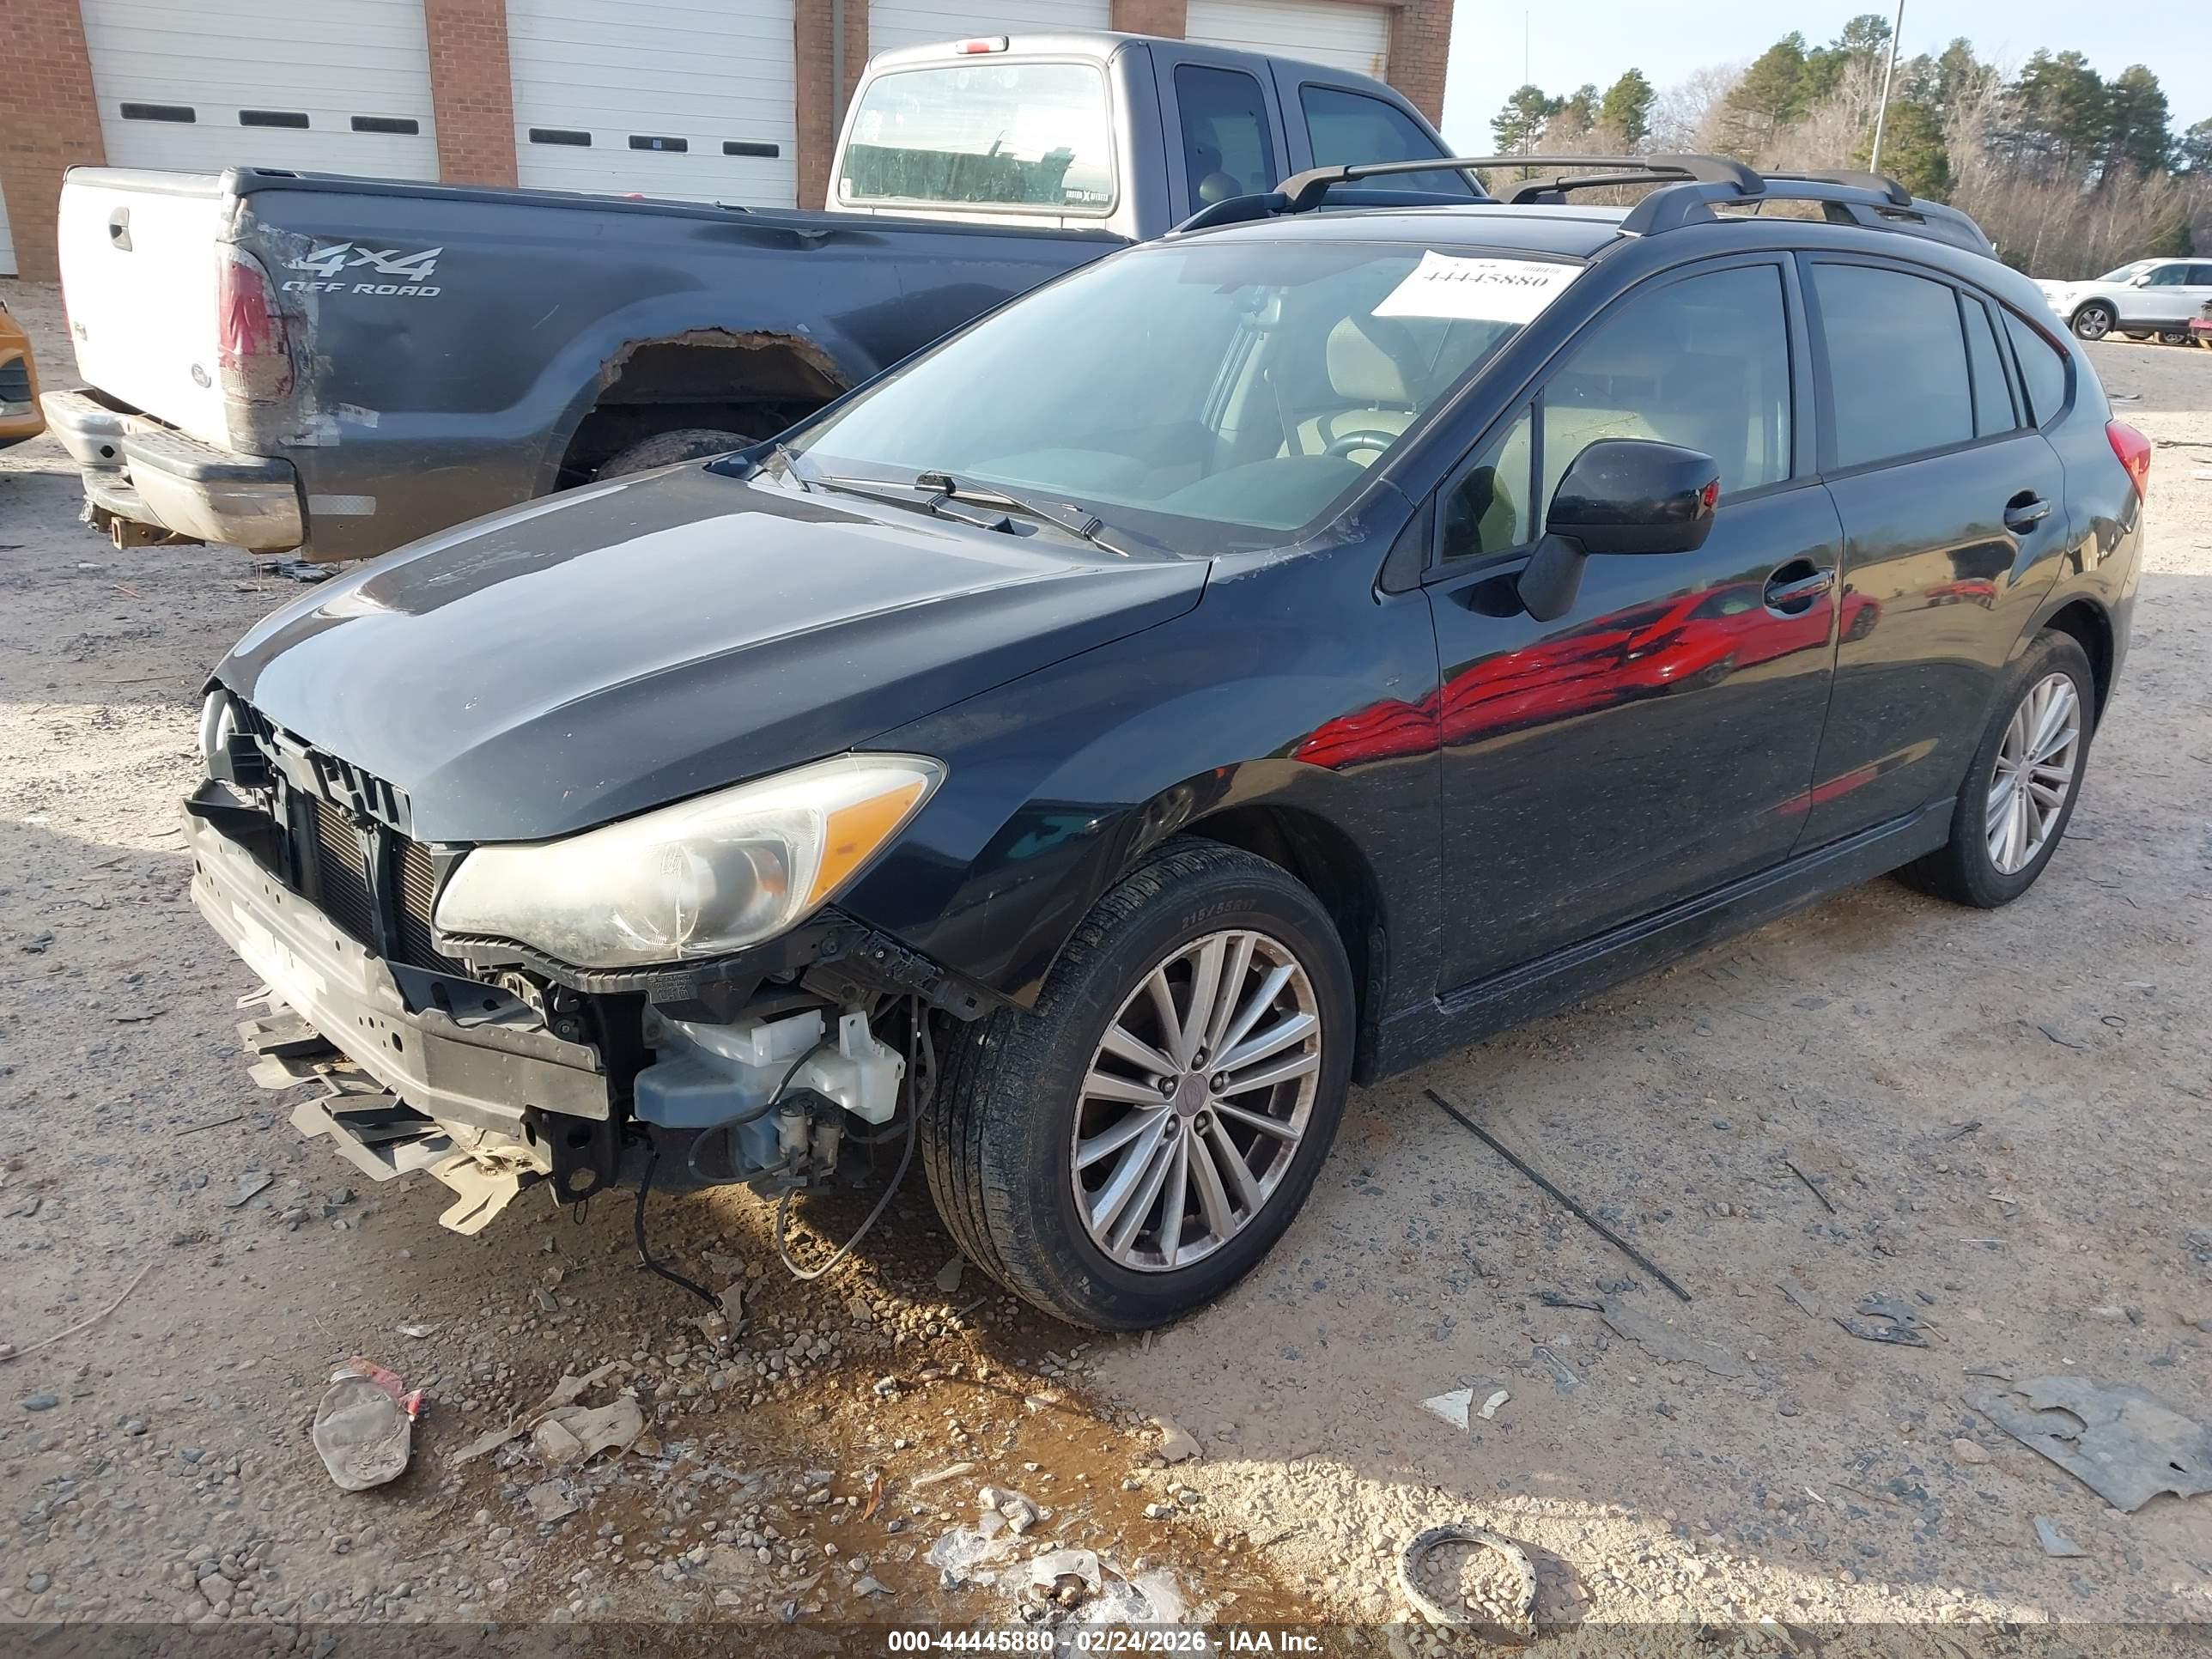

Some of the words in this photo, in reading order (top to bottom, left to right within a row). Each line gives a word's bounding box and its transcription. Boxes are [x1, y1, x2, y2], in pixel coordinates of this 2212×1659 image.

[1423, 271, 1549, 288] 44445880
[281, 281, 346, 293] OFF
[352, 283, 441, 297] ROAD
